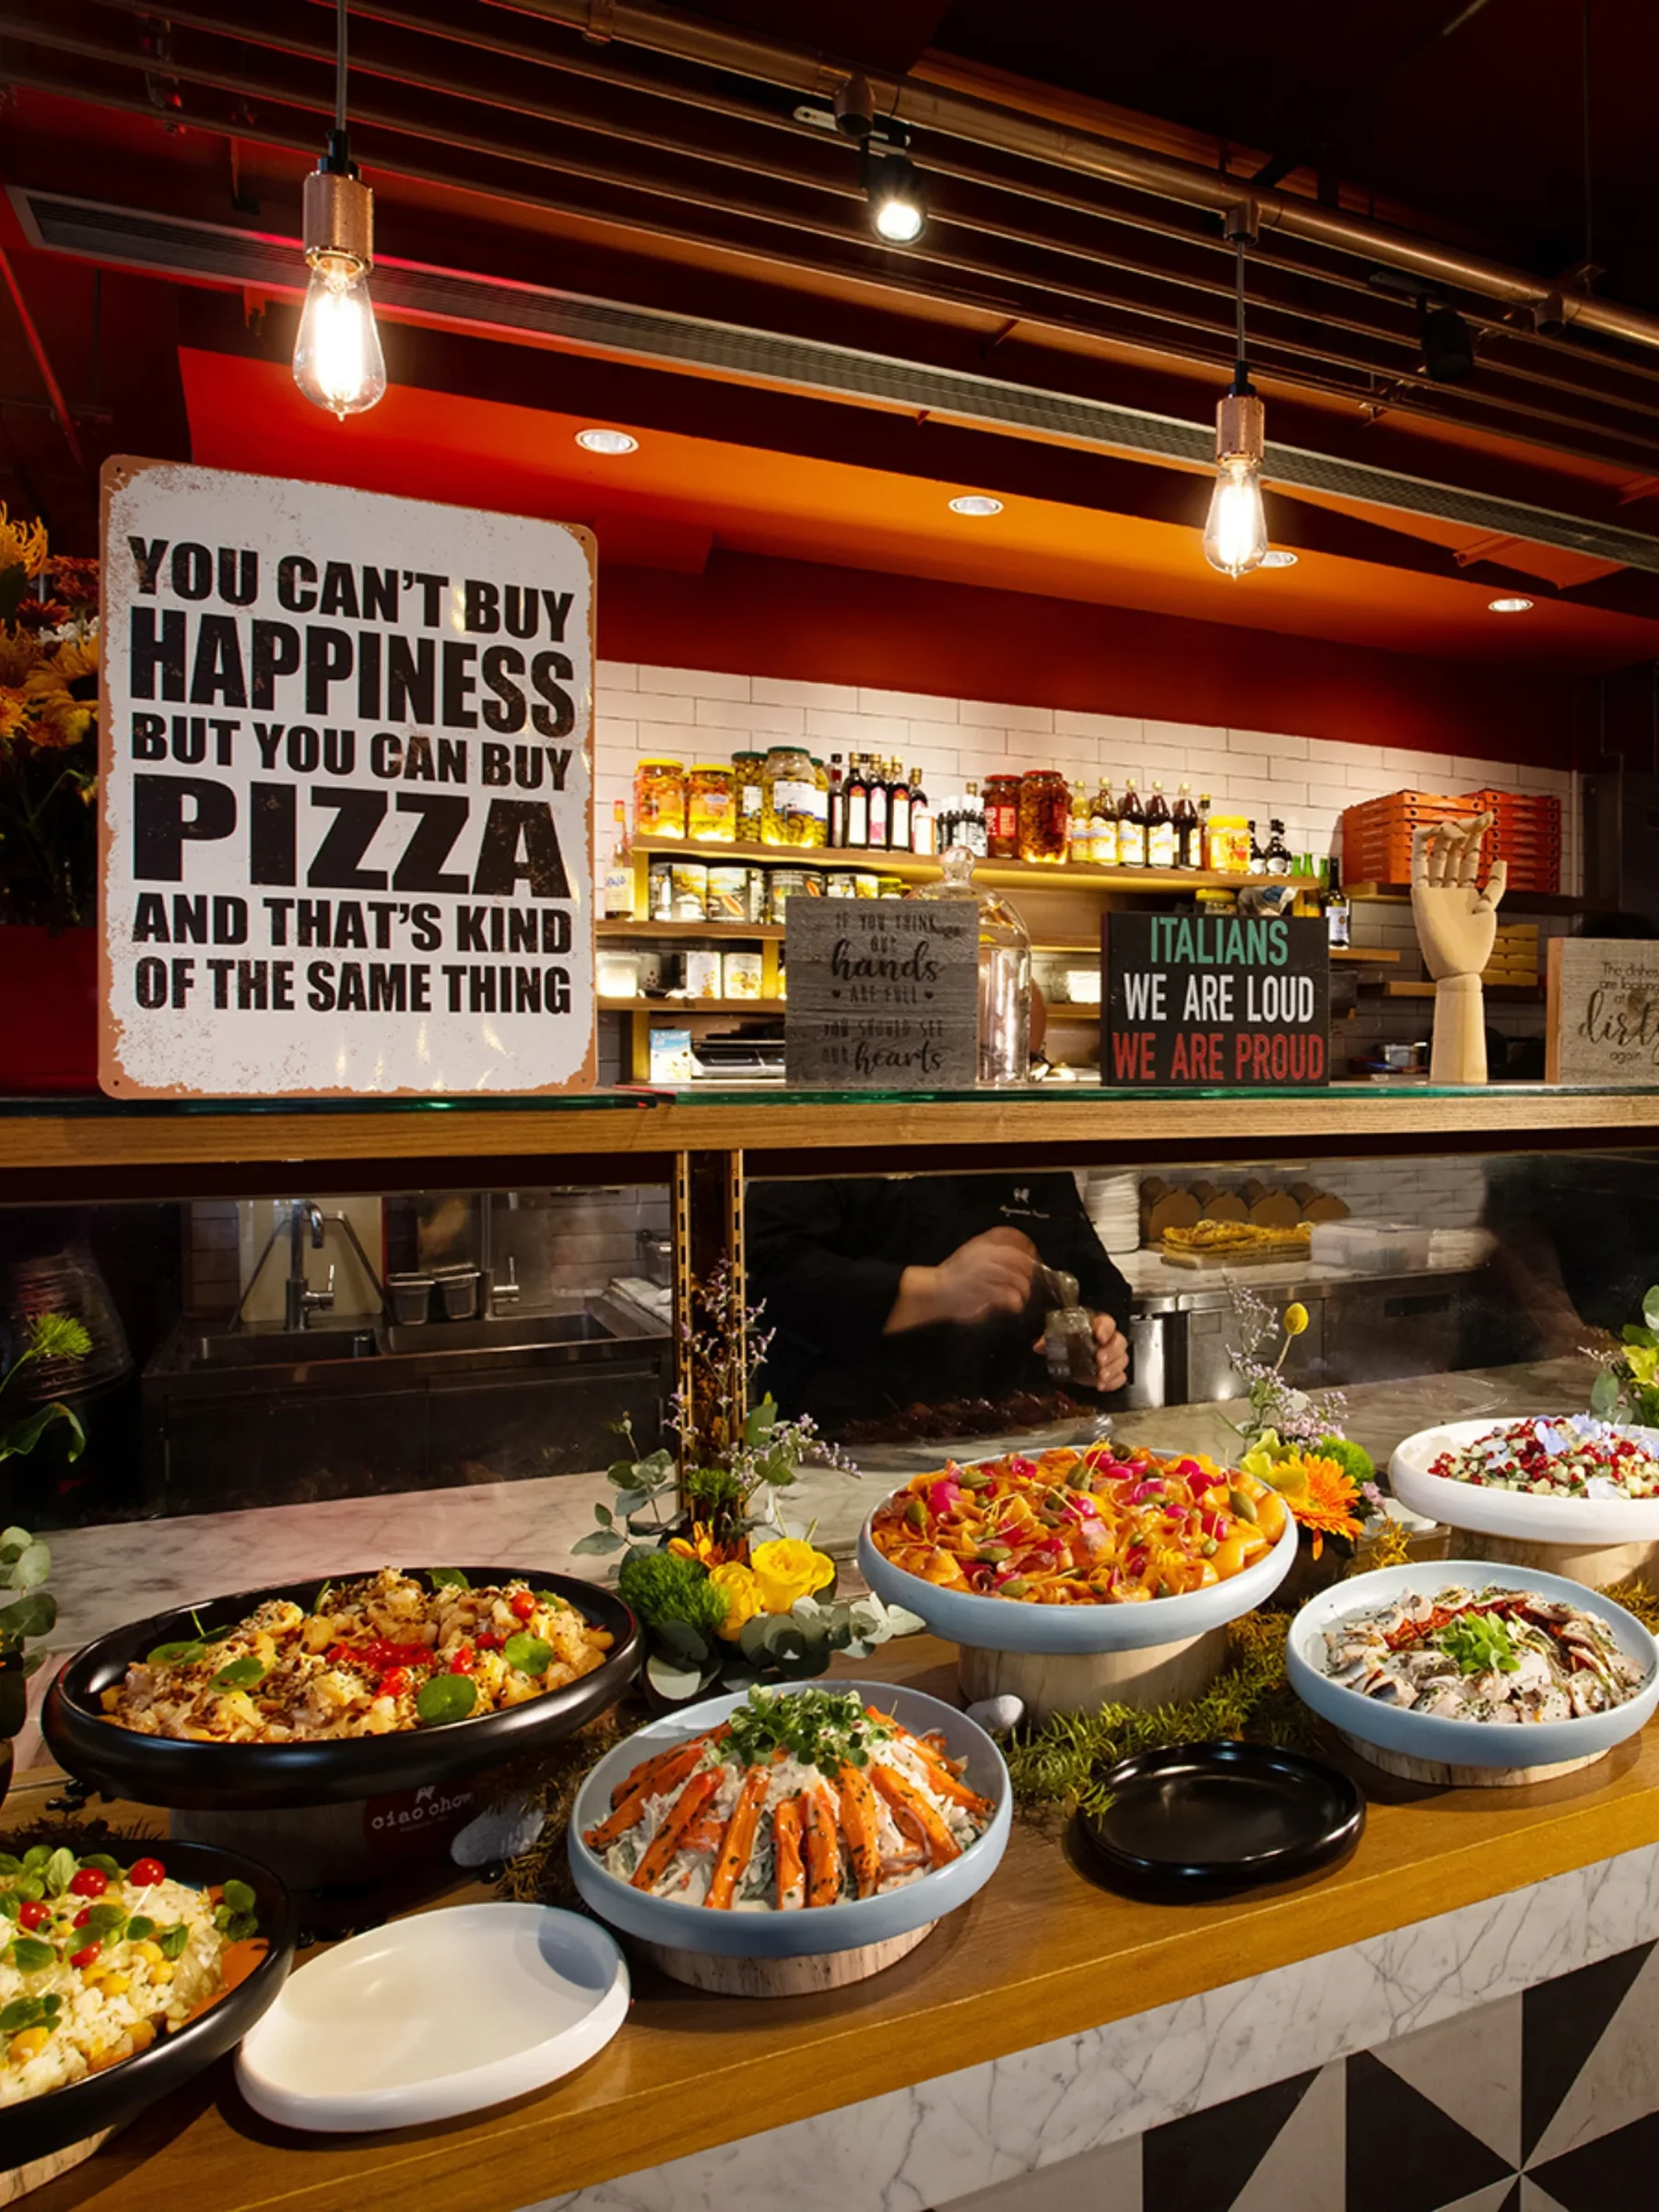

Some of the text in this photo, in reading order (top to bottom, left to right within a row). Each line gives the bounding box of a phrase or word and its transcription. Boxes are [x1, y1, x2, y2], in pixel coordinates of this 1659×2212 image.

[127, 535, 575, 643] YOU CAN'T BUY
[129, 605, 576, 740] HAPPINESS
[131, 712, 572, 792] BUT YOU CAN BUY
[133, 772, 572, 900] PIZZA
[132, 892, 572, 955] AND THAT'S KIND
[835, 912, 935, 933] IF YOU THINK
[1151, 916, 1288, 966] ITALIANS
[832, 938, 945, 982] hands
[1602, 961, 1622, 977] The
[135, 956, 572, 1016] OF THE SAME THING
[850, 985, 876, 1003] ARE
[1124, 972, 1314, 1023] WE ARE LOUD
[920, 1019, 944, 1039] SEE
[854, 1041, 947, 1075] hearts
[1112, 1032, 1324, 1080] WE ARE PROUD
